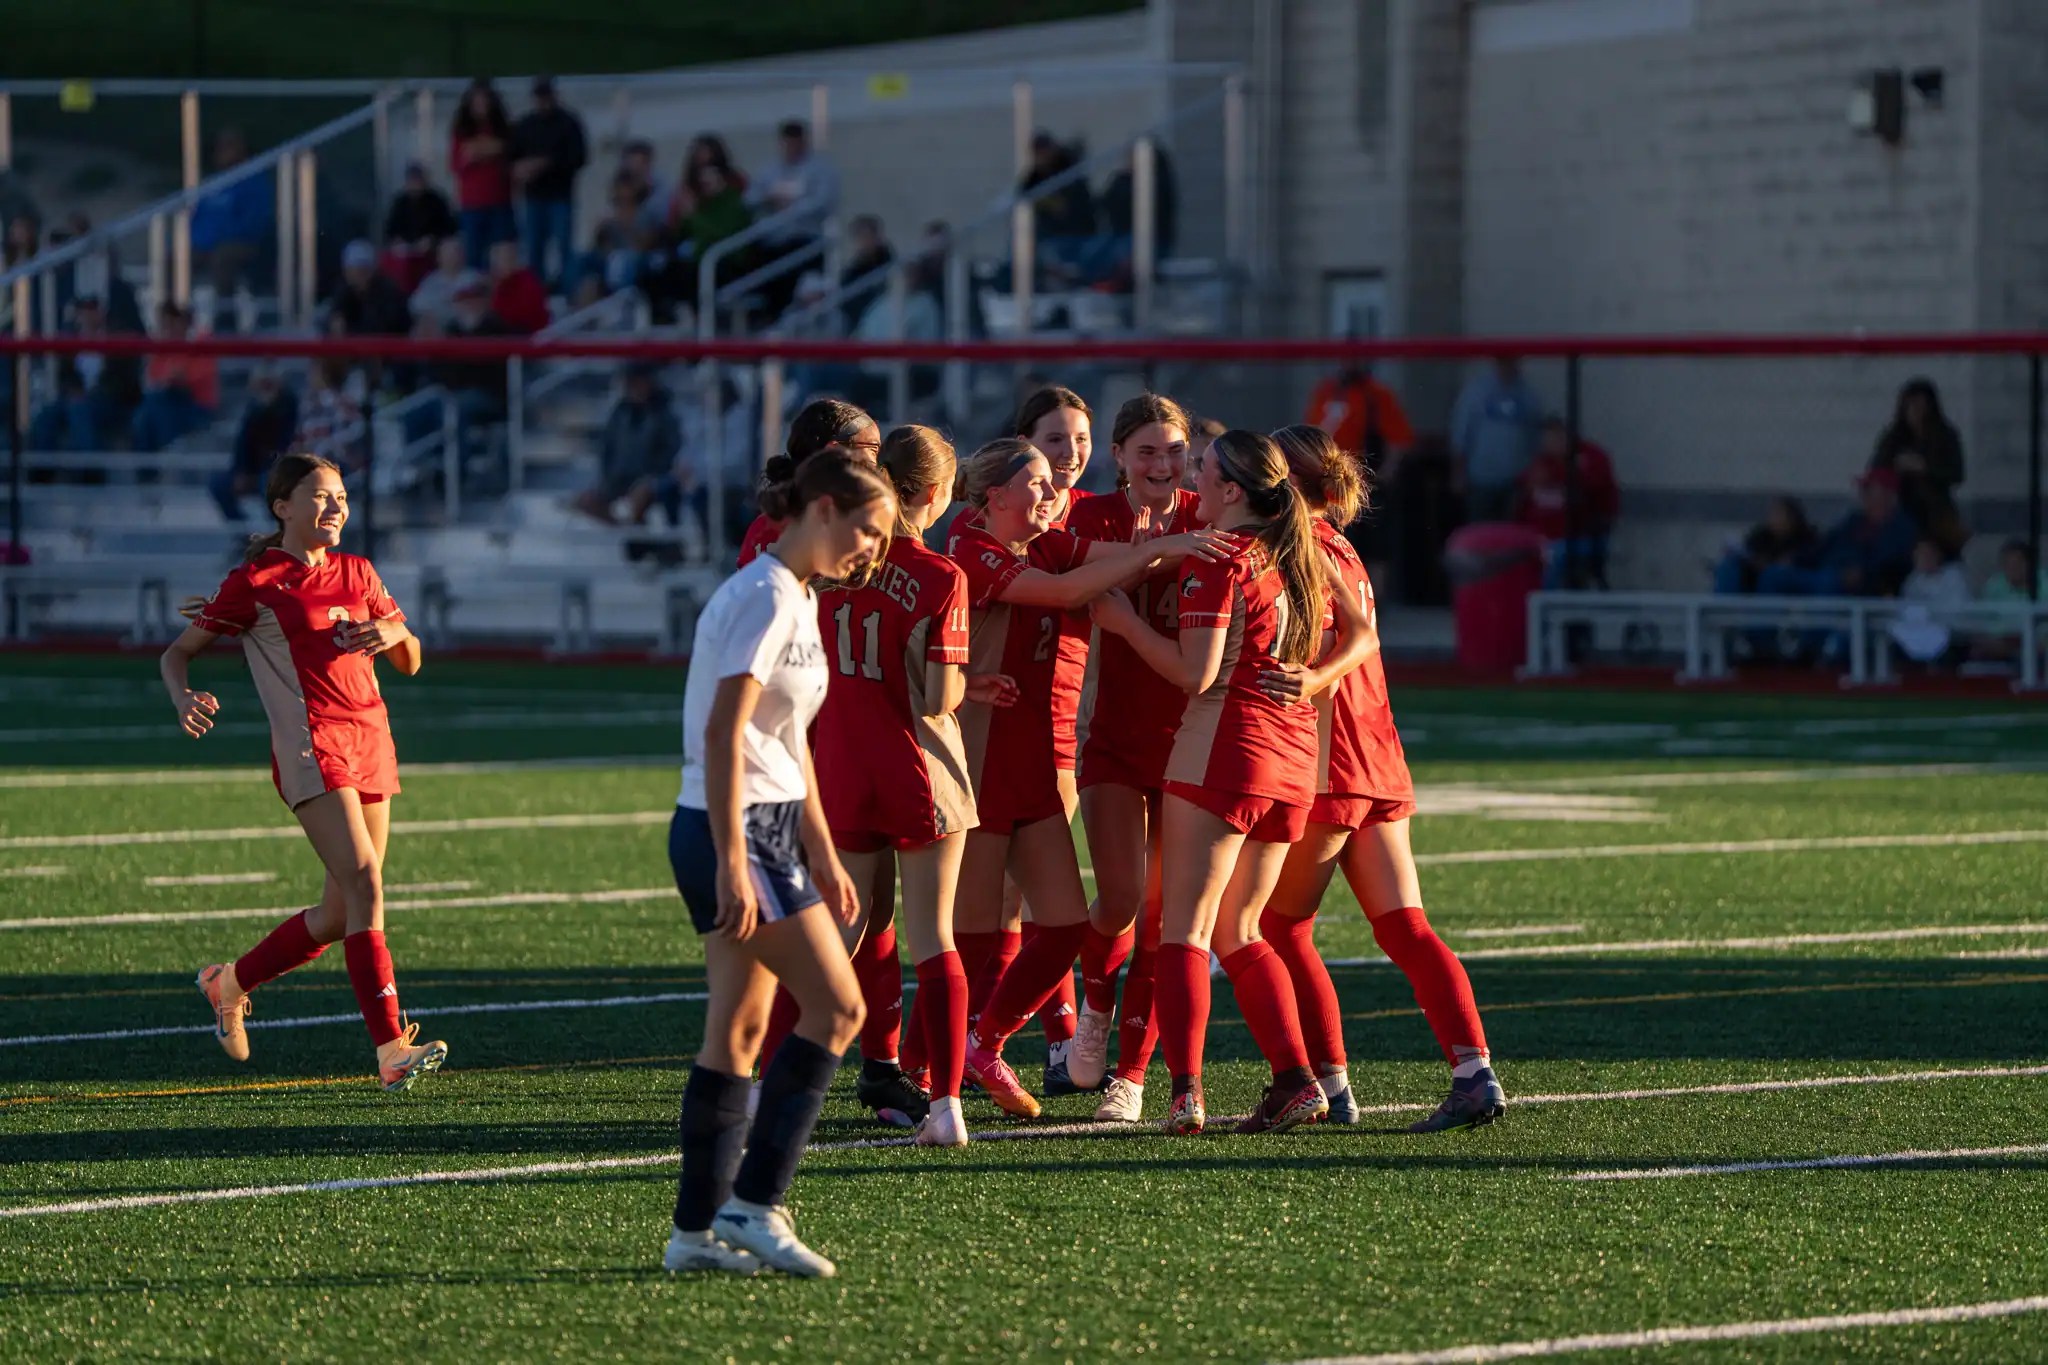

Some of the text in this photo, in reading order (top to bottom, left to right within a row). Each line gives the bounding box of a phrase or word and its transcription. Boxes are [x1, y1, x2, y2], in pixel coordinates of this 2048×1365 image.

[980, 551, 1003, 570] 2
[870, 561, 921, 613] IES
[1137, 582, 1179, 628] 14
[833, 601, 883, 681] 11
[951, 607, 968, 632] 11
[1033, 616, 1053, 661] 2
